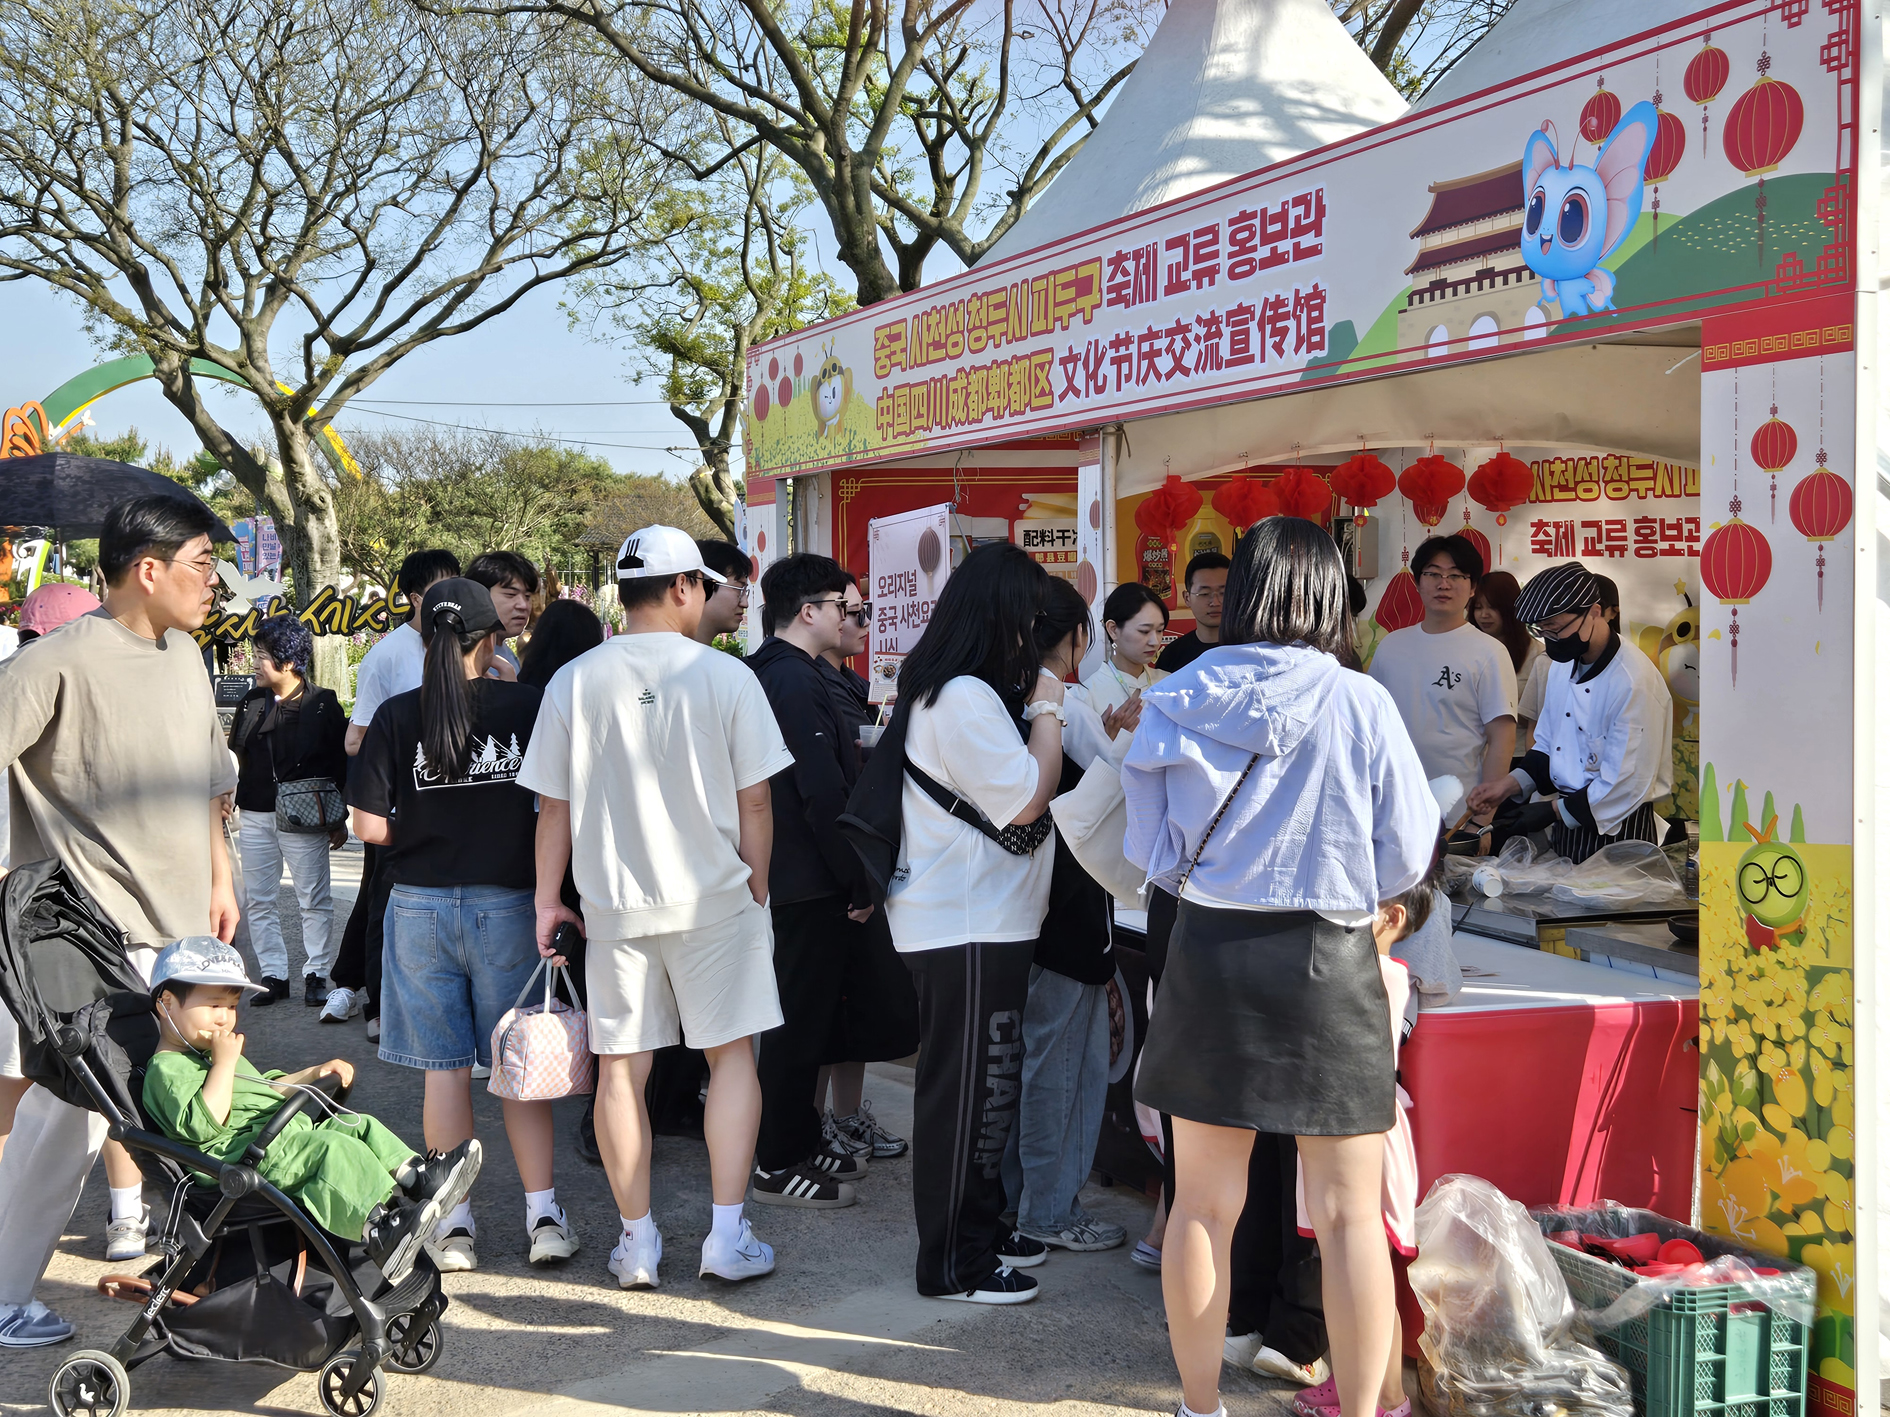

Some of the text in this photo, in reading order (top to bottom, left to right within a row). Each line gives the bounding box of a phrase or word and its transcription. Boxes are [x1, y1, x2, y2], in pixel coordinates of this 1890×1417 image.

[874, 318, 907, 379] 중국
[909, 299, 965, 371] 사천성
[1107, 241, 1158, 308] 축제
[1164, 222, 1220, 297] 교류
[1227, 188, 1326, 281] 홍보관
[1529, 456, 1600, 503] 사천성
[1530, 519, 1576, 558] 축제
[1581, 519, 1628, 558] 교류
[877, 569, 918, 598] 오리지널
[877, 605, 898, 634] 중국
[143, 1284, 171, 1318] leclerc
